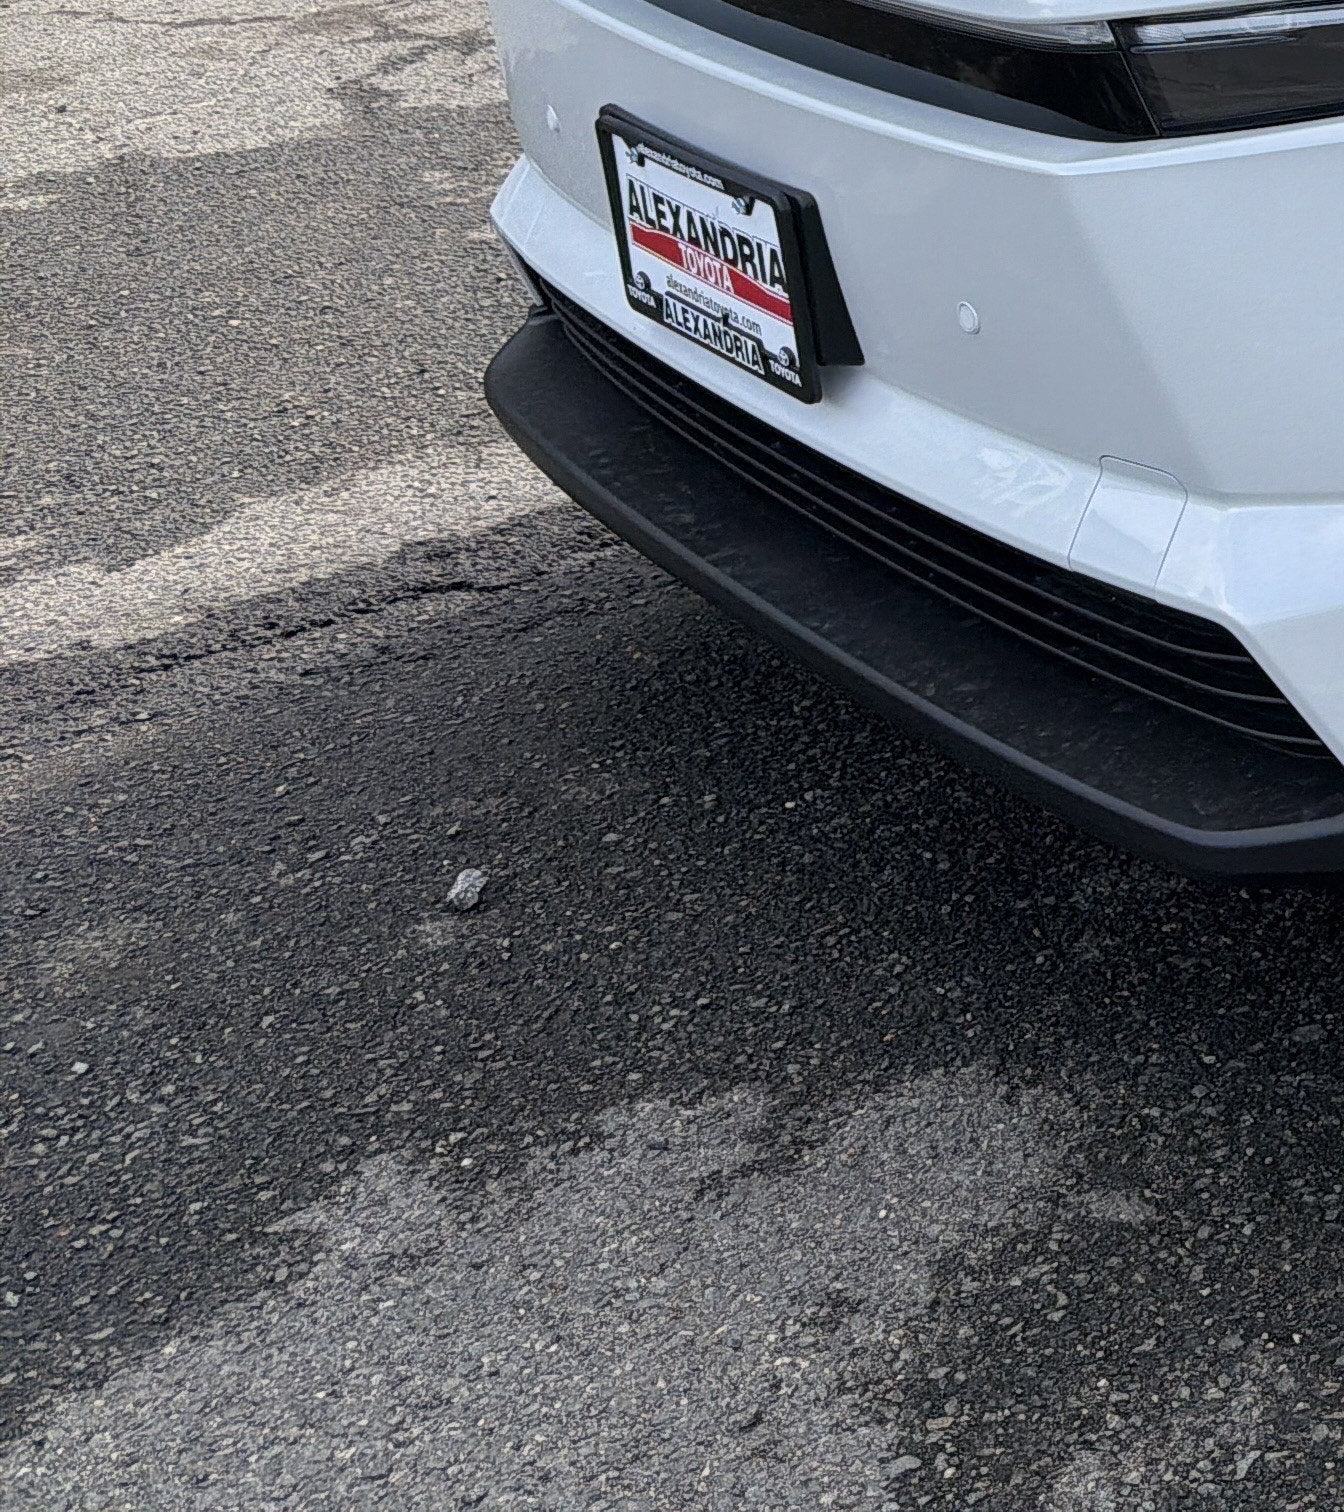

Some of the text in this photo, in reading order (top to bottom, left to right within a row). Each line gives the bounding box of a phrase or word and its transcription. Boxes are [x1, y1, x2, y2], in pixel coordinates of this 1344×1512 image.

[627, 177, 786, 290] ALEXANDRIA
[627, 284, 656, 309] TOYOTA
[678, 241, 736, 294] TOYOTA
[665, 274, 763, 337] alexandriatoyota.com
[663, 296, 764, 375] ALEXANDRIA
[768, 359, 803, 387] TOYOTA
